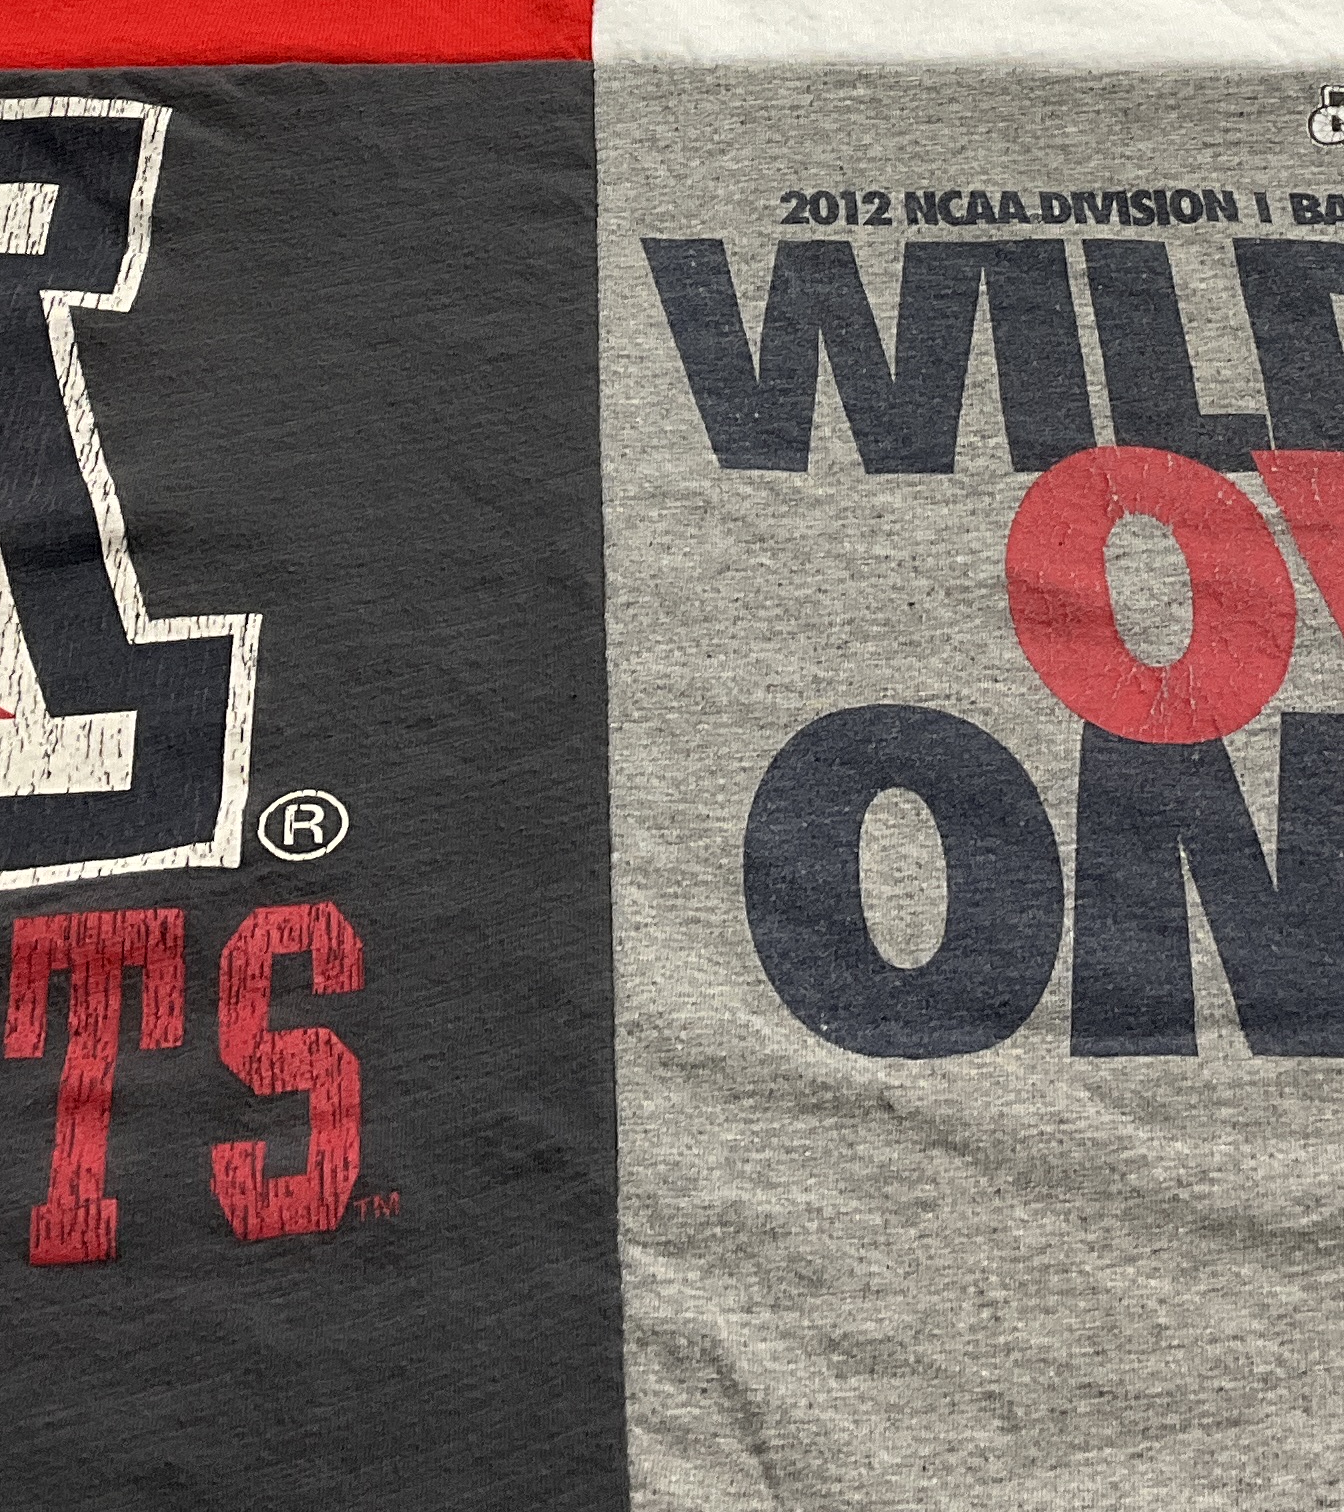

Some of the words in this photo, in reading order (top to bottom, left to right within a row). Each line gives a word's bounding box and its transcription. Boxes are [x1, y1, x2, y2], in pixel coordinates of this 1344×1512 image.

[778, 189, 894, 228] 2012
[902, 189, 1031, 227] NCAA
[1038, 189, 1241, 227] DIVISION
